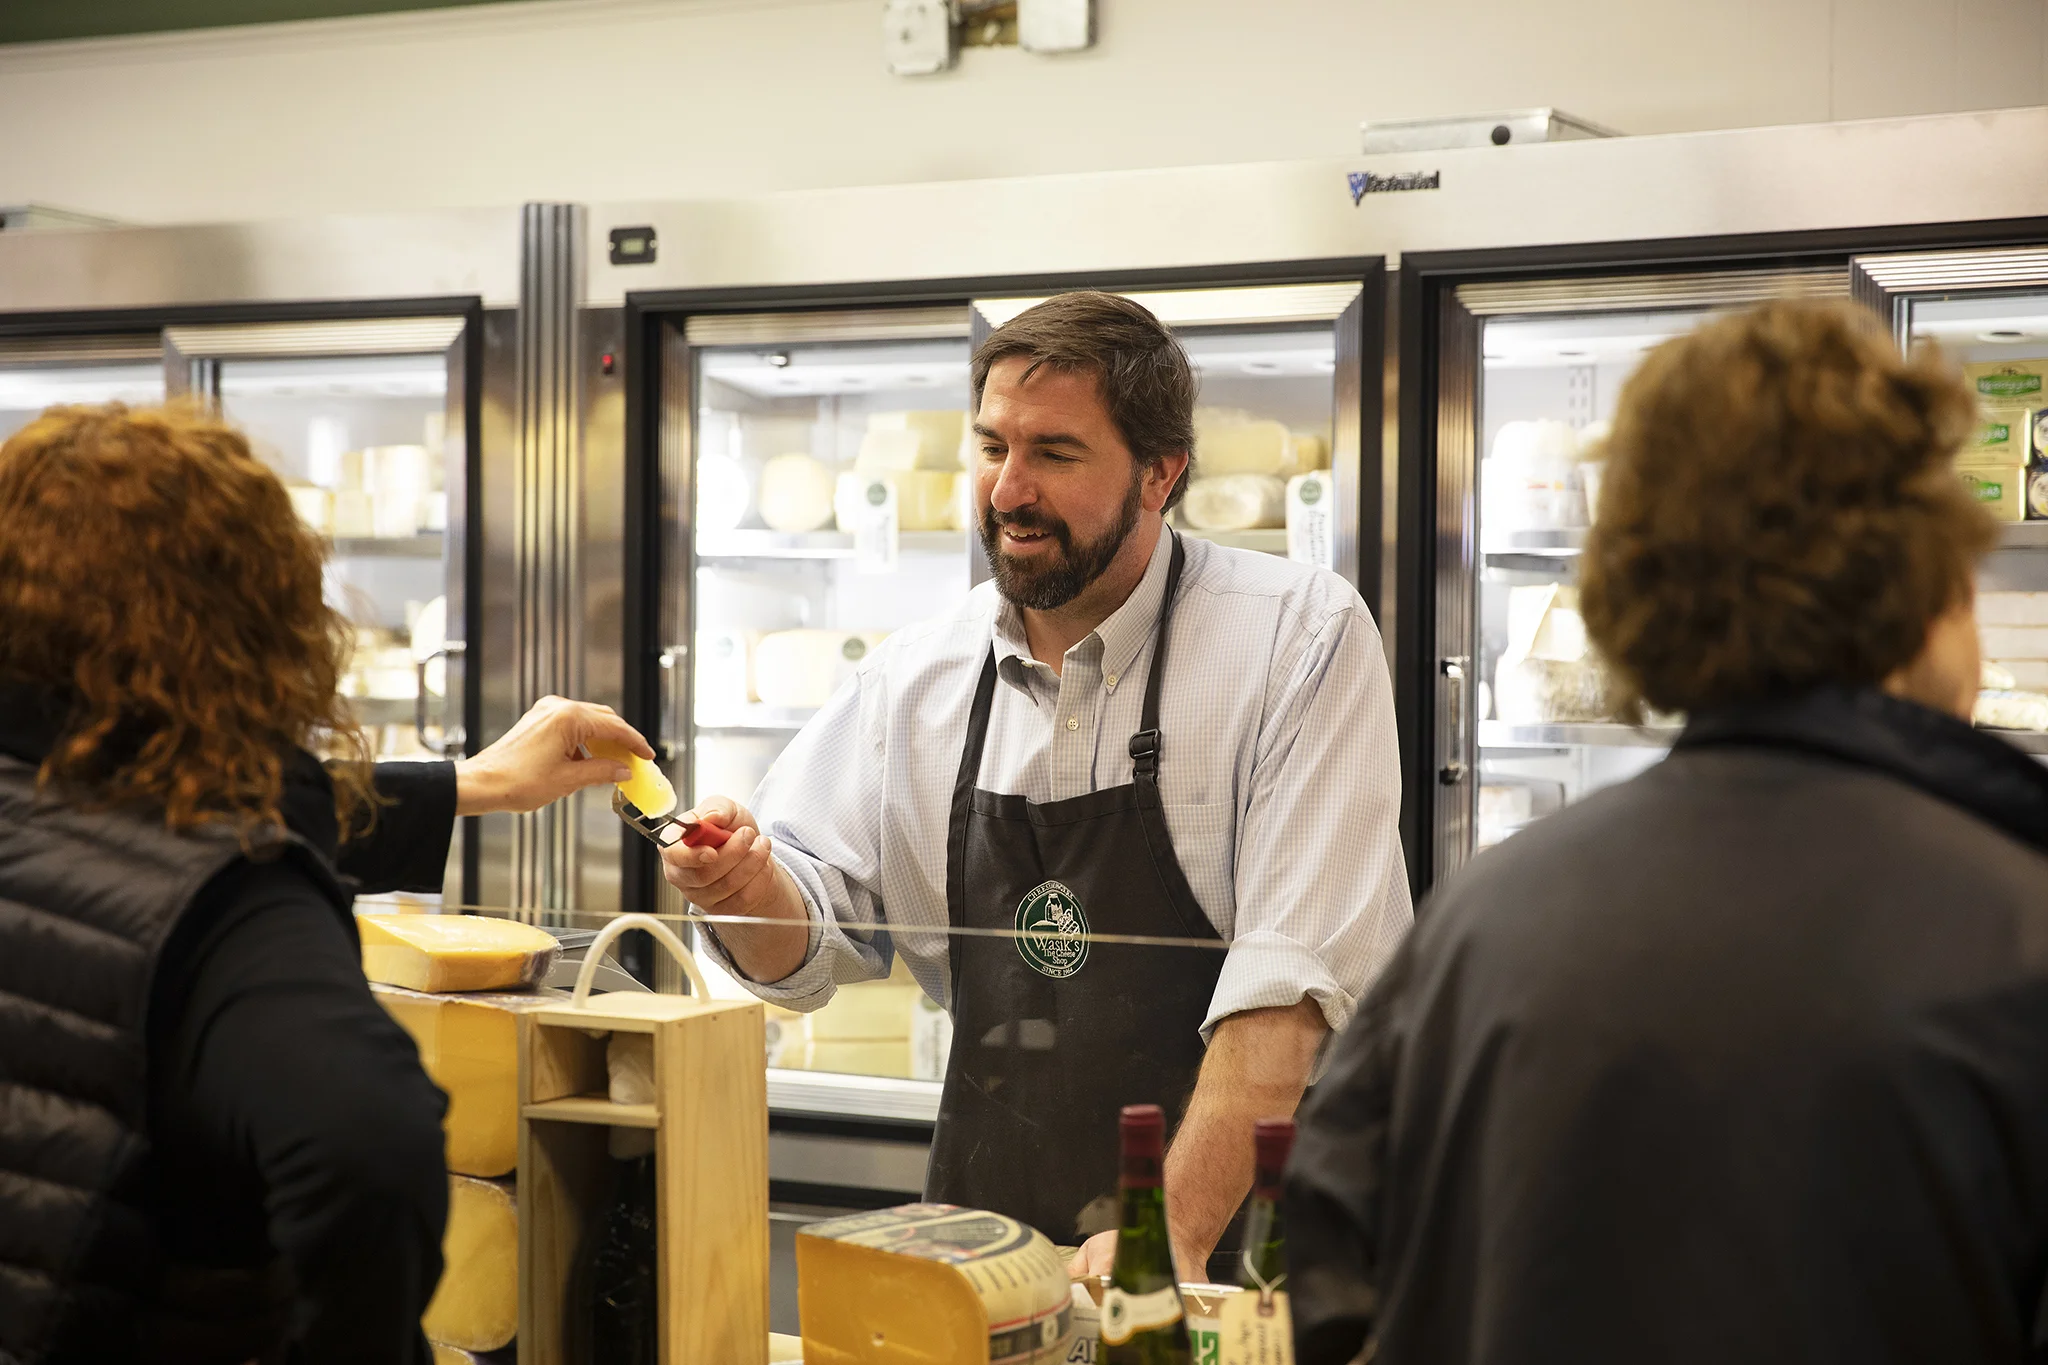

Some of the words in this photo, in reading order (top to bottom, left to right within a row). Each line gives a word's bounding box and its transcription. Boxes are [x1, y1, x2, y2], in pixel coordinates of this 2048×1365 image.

[1031, 934, 1080, 952] Wasik's
[1041, 948, 1055, 957] The
[1055, 949, 1076, 958] Cheese
[1052, 956, 1068, 967] Shop
[1041, 966, 1062, 976] SINCE
